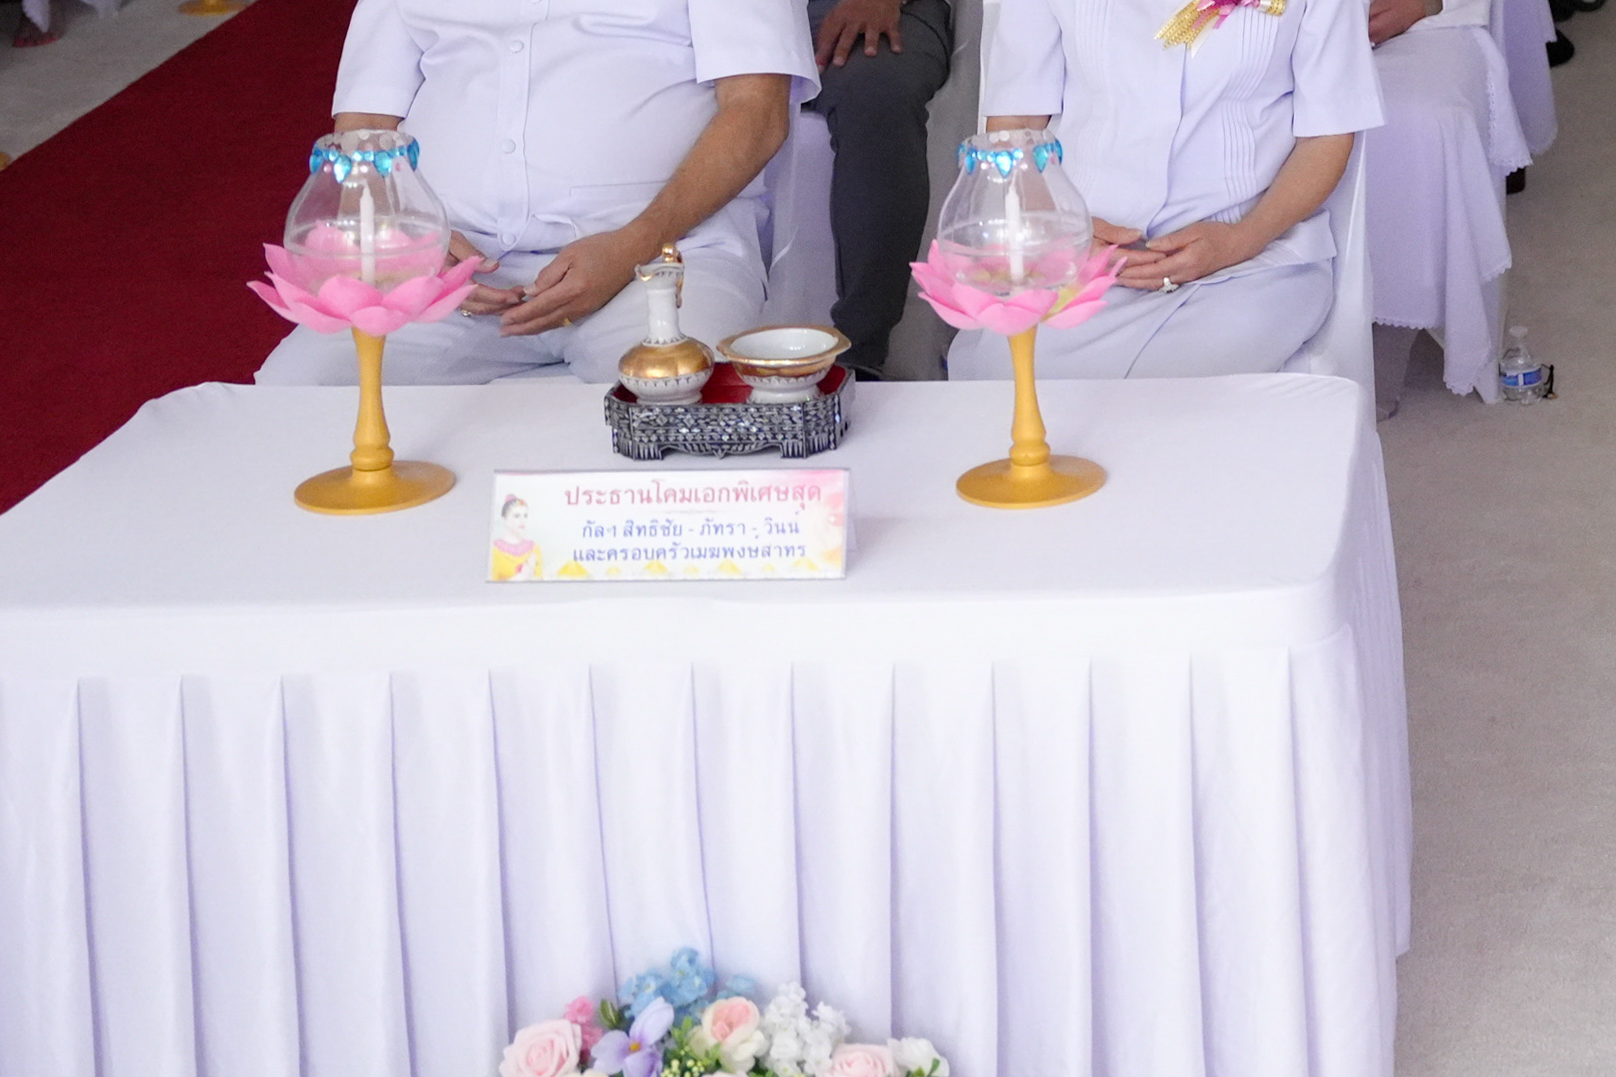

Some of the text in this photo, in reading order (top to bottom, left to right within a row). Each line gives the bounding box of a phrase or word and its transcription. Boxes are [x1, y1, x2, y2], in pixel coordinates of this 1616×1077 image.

[564, 478, 821, 511] ประธานโคมเอกพิเศษสุด
[623, 518, 683, 538] สิทธิชัย
[700, 517, 746, 536] ภัทรา
